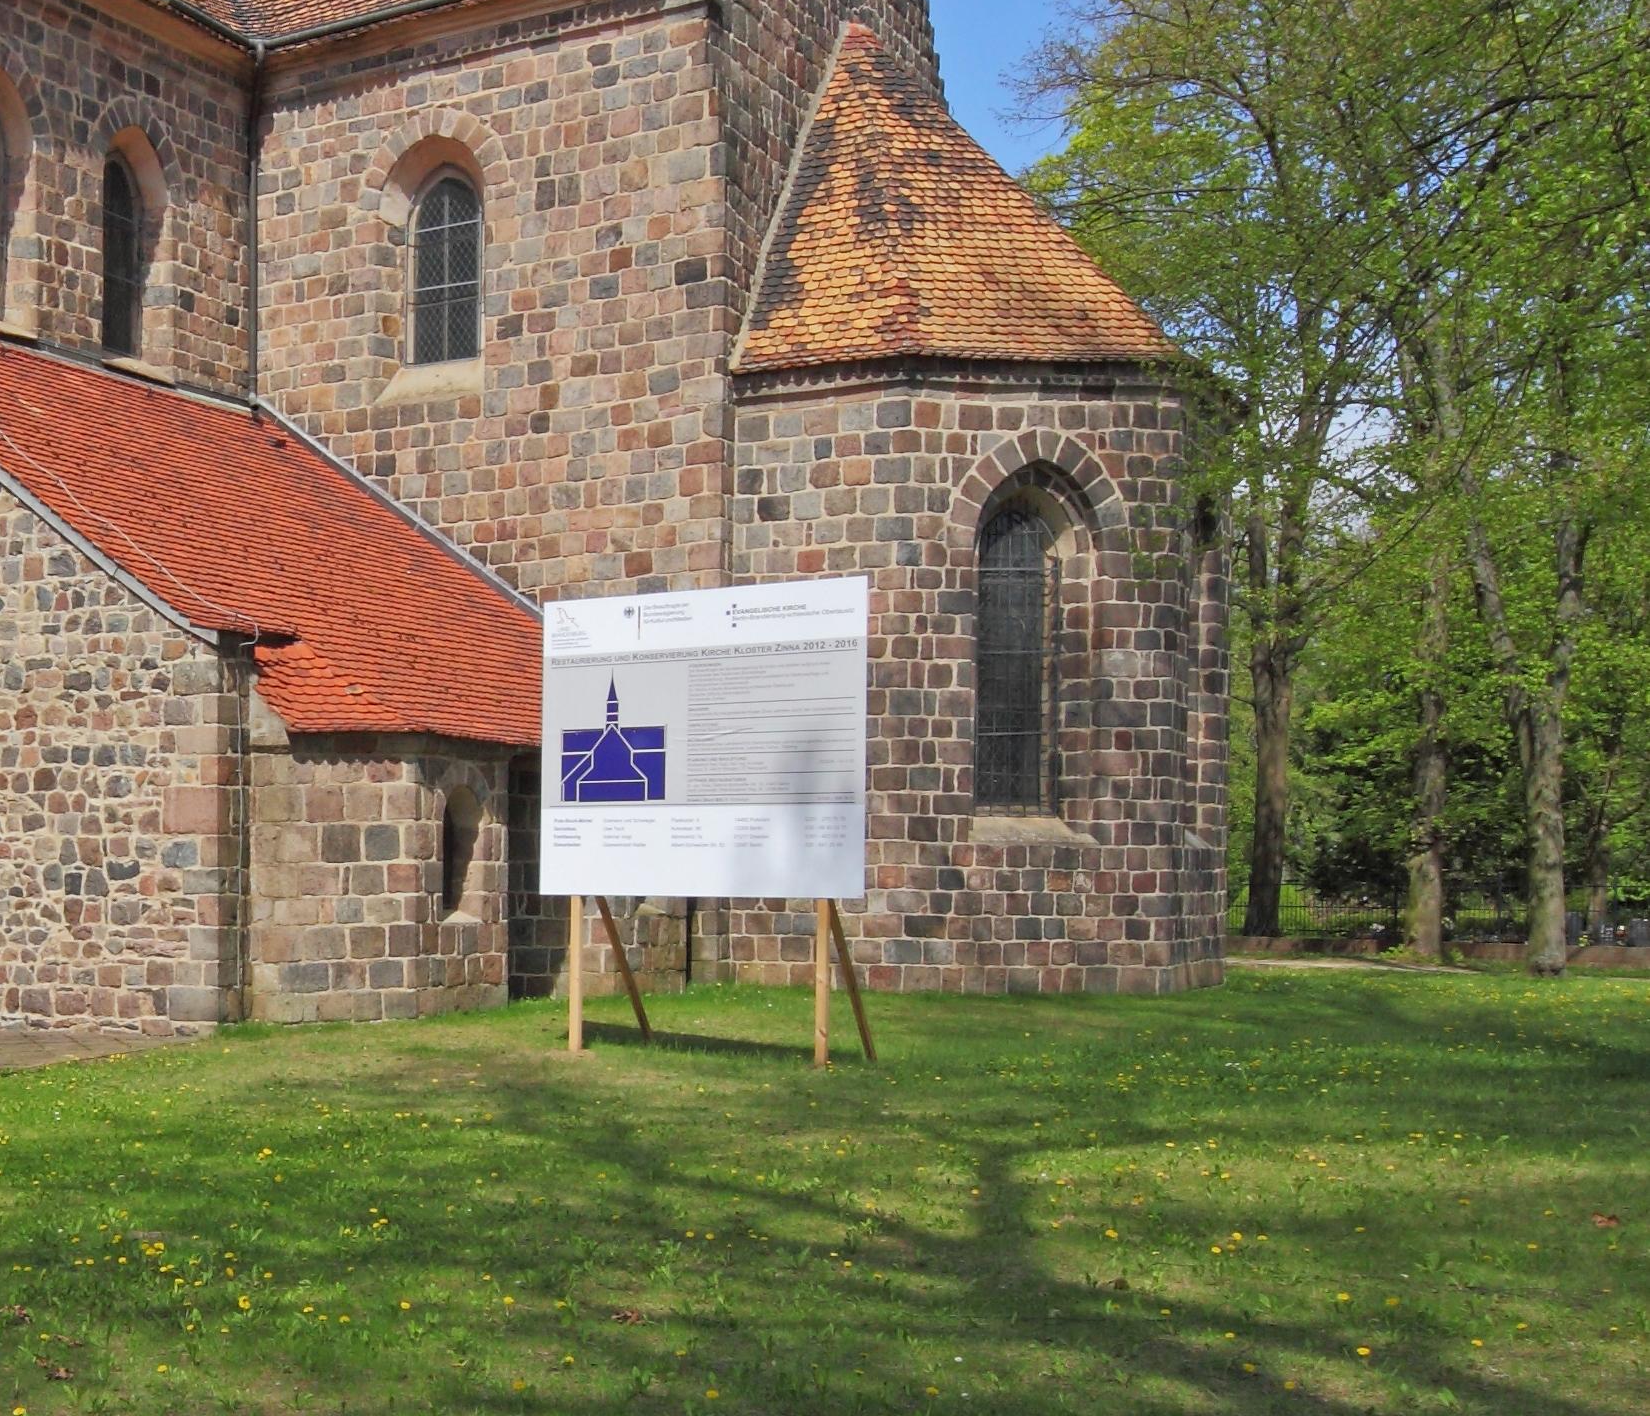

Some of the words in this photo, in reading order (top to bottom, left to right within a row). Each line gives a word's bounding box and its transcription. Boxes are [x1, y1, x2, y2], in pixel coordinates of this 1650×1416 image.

[734, 645, 772, 655] KLOSTER
[803, 640, 826, 650] 2012
[834, 639, 858, 649] 2016
